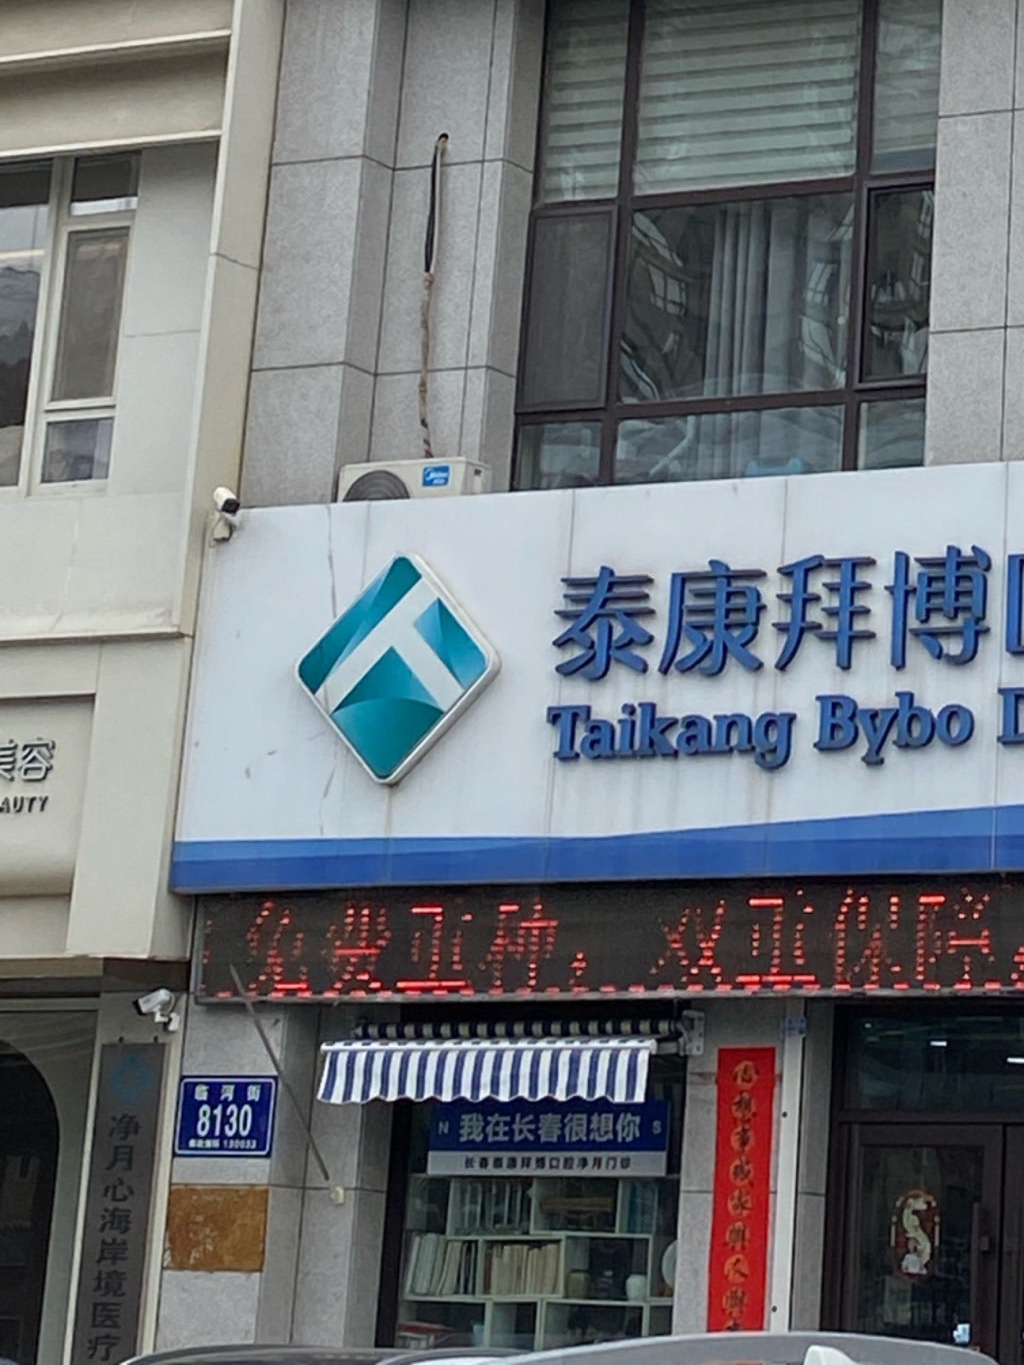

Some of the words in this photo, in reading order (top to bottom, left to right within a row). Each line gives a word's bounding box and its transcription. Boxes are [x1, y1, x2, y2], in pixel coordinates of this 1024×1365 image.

[547, 701, 796, 769] Taikang
[814, 691, 975, 765] Bybo
[197, 1103, 252, 1137] 8130
[438, 1120, 449, 1134] N
[459, 1112, 641, 1143] 我在长春很想你
[652, 1120, 662, 1134] S
